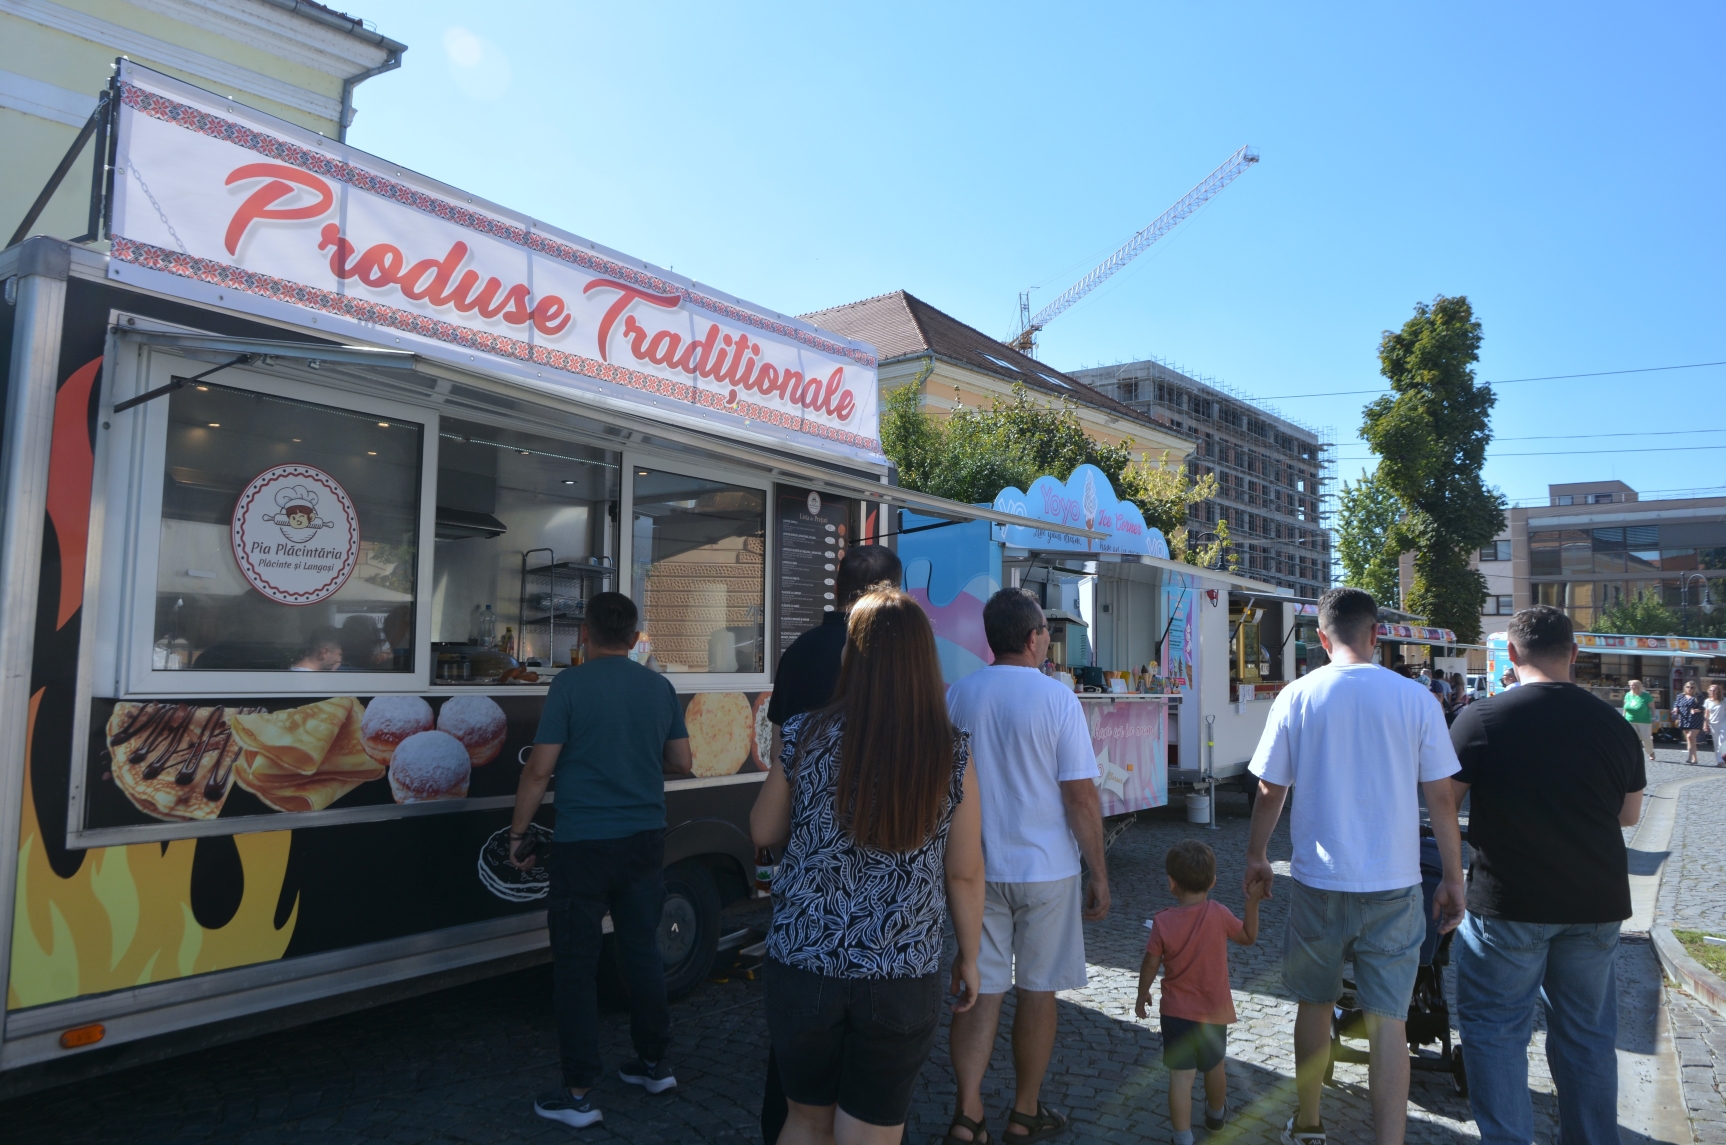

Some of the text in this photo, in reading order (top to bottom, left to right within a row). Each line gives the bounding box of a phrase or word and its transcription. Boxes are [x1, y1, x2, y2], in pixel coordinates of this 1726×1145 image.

[224, 162, 857, 422] Produse Tradiționale
[1098, 508, 1142, 536] Ice Corner
[250, 541, 343, 560] Pia Plăcintăria
[258, 559, 292, 569] Plăcinte
[303, 562, 335, 573] Langoși
